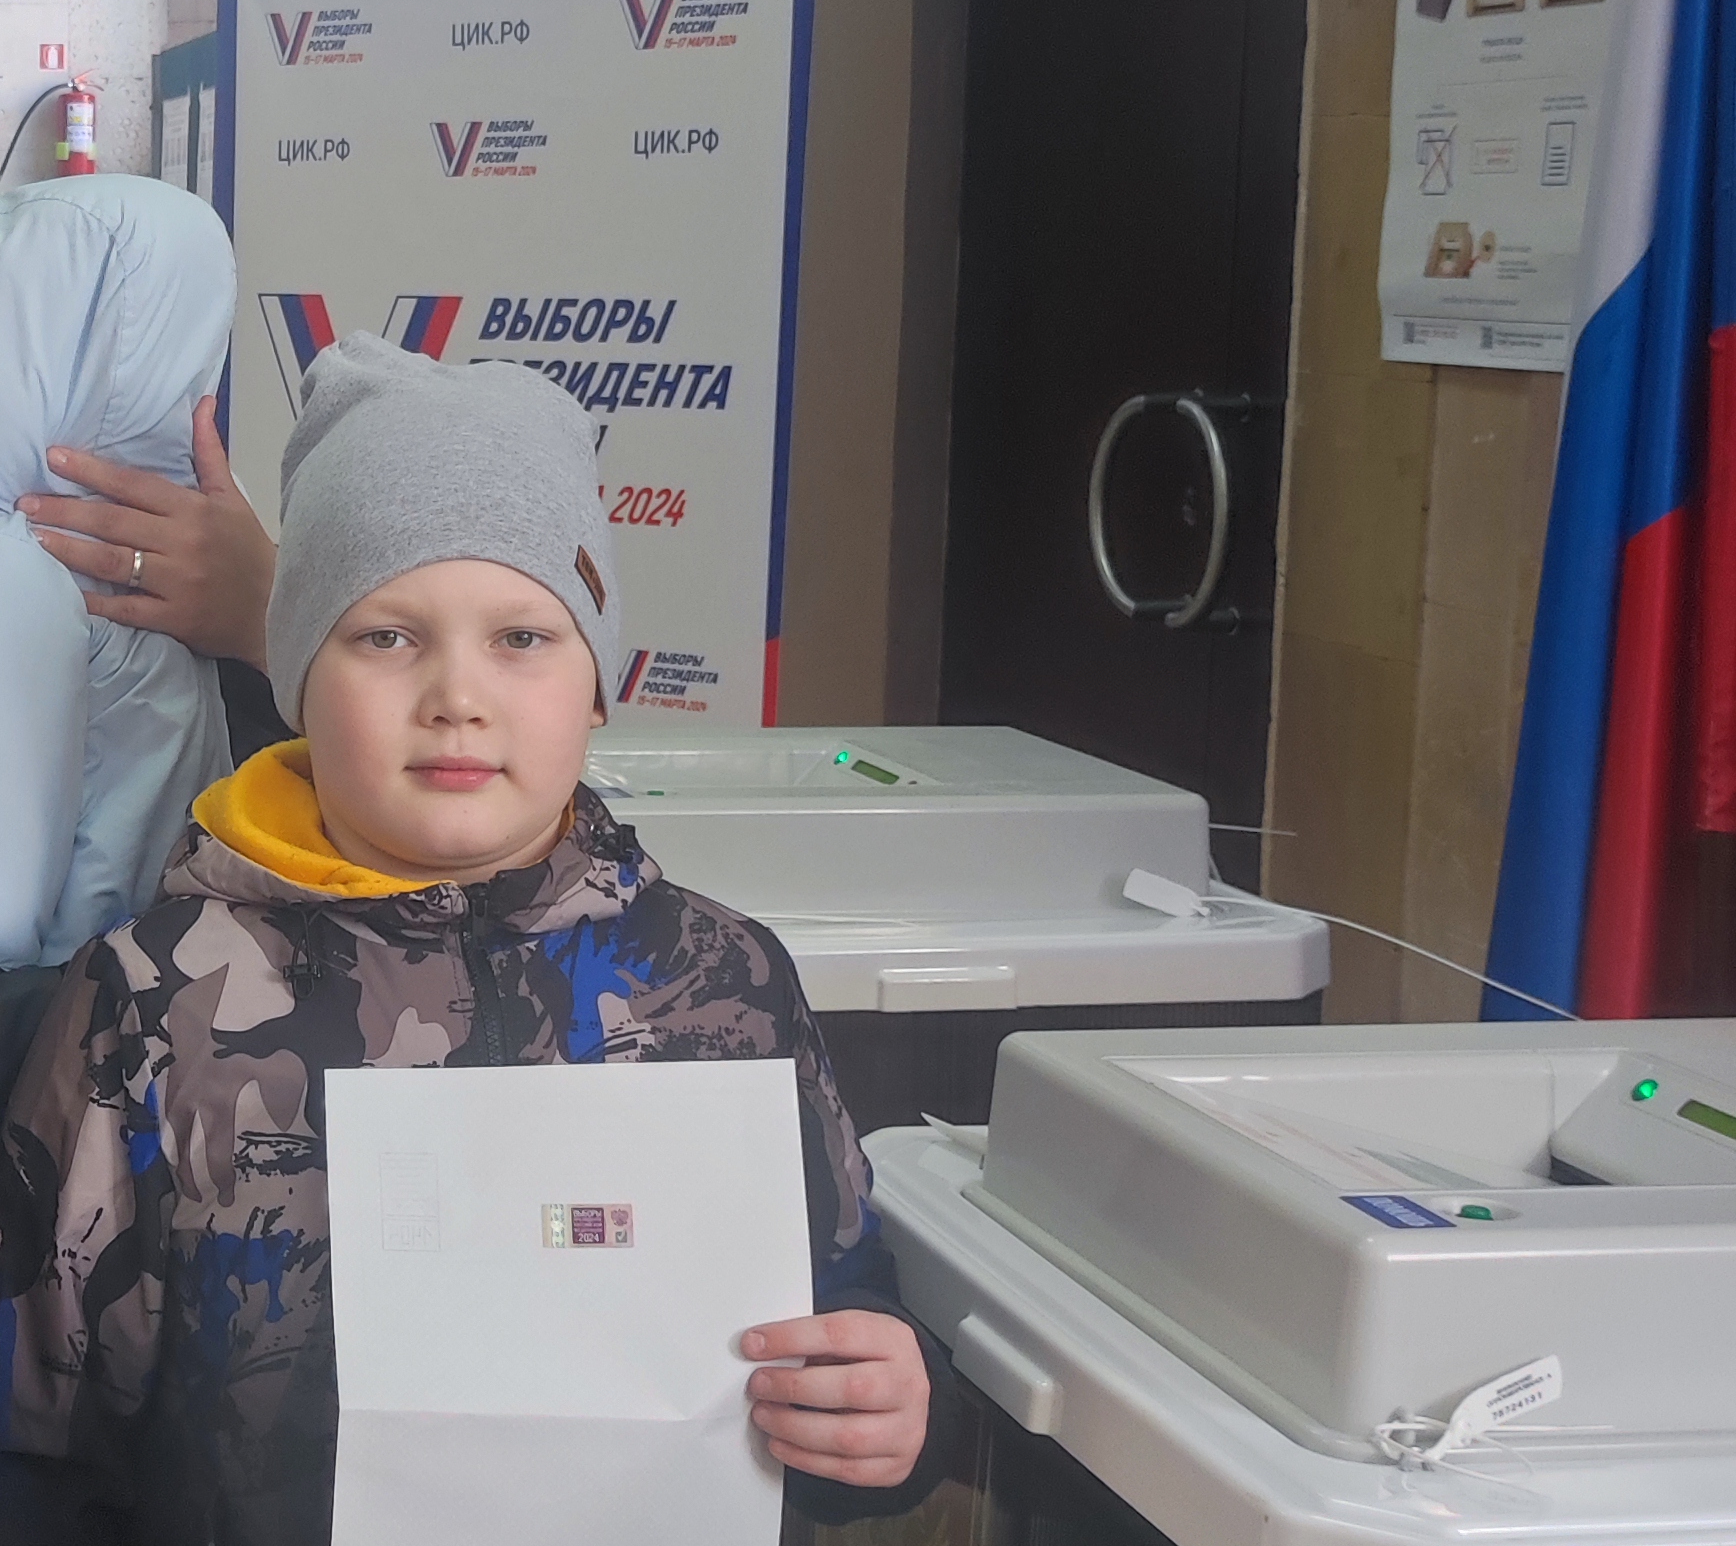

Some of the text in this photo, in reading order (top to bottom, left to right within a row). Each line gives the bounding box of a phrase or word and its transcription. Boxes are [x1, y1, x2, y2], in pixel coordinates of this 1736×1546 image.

[317, 9, 360, 22] ВЫБОРЫ
[675, 2, 749, 18] ПРЕЗИДЕНТА
[311, 23, 372, 37] ПРЕЗИДЕНТА
[668, 20, 716, 34] РОССИИ
[451, 19, 531, 51] ЦИК.РФ
[687, 36, 715, 47] МАРТА
[716, 35, 736, 46] 2024
[307, 40, 346, 52] РОССИИ
[323, 54, 345, 64] МАРТА
[346, 53, 364, 63] 2024
[486, 119, 534, 133] ВЫБОРЫ
[481, 135, 548, 149] ПРЕЗИДЕНТА
[633, 128, 720, 159] ЦИК.РФ
[278, 137, 351, 166] ЦИК.РФ
[475, 152, 518, 164] РОССИИ
[493, 166, 517, 176] МАРТА
[518, 166, 537, 176] 2024
[478, 297, 677, 344] ВЫБОРЫ
[609, 486, 687, 527] 2024
[654, 651, 704, 667] ВЫБОРЫ
[647, 666, 719, 684] ПРЕЗИДЕНТА
[641, 681, 687, 696] РОССИИ
[659, 697, 686, 709] МАРТА
[687, 699, 708, 712] 2024
[578, 1233, 599, 1242] 2024
